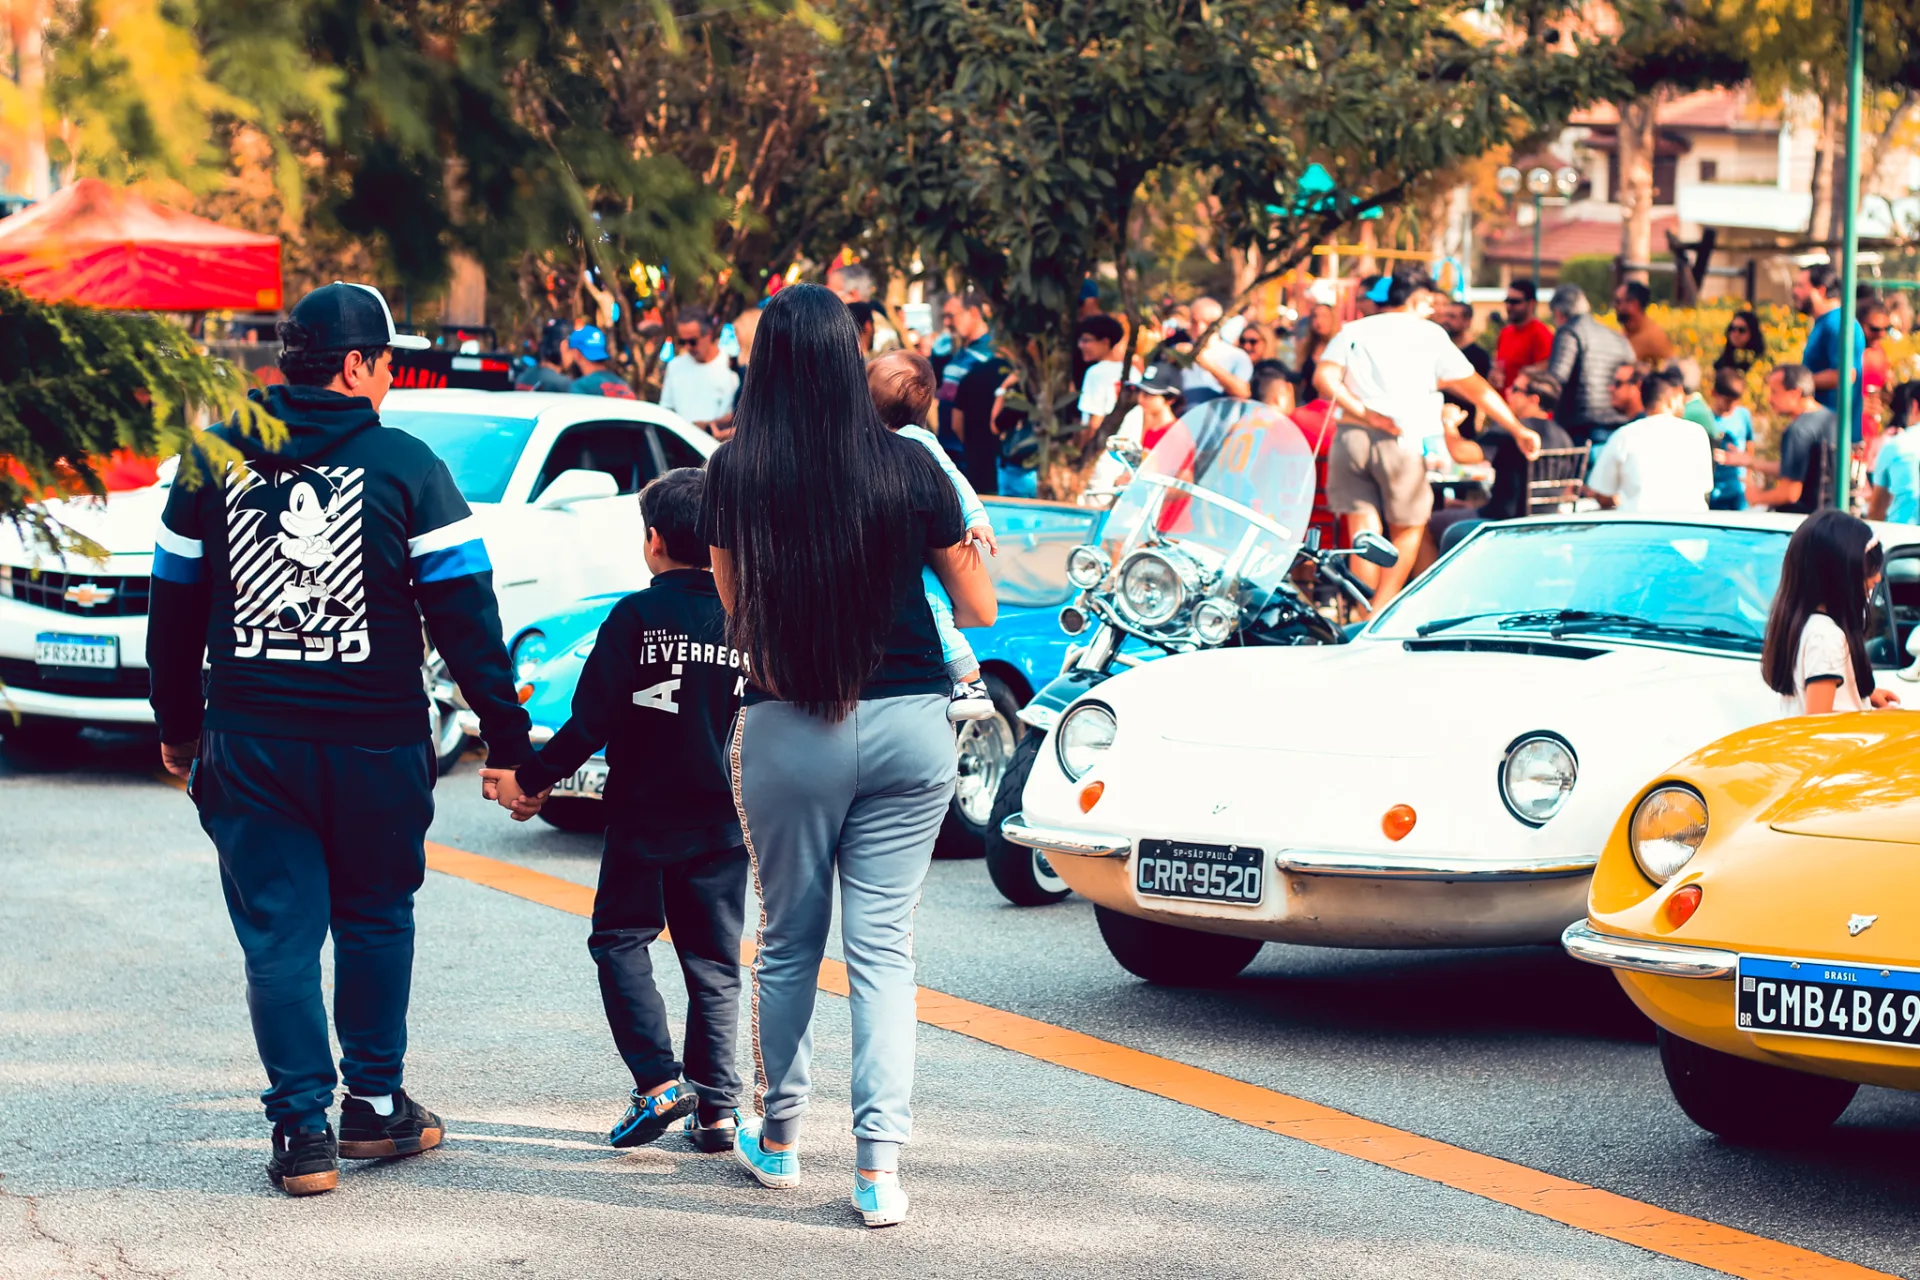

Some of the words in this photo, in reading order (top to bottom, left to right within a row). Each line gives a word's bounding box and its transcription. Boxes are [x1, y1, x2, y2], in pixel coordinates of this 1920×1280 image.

[233, 626, 371, 663] ソニック
[1206, 851, 1233, 861] PAULO
[1138, 857, 1261, 899] CRR-9520
[1824, 970, 1857, 982] BRASIL
[1740, 1012, 1752, 1027] BR
[1757, 981, 1920, 1037] CMB4B69
